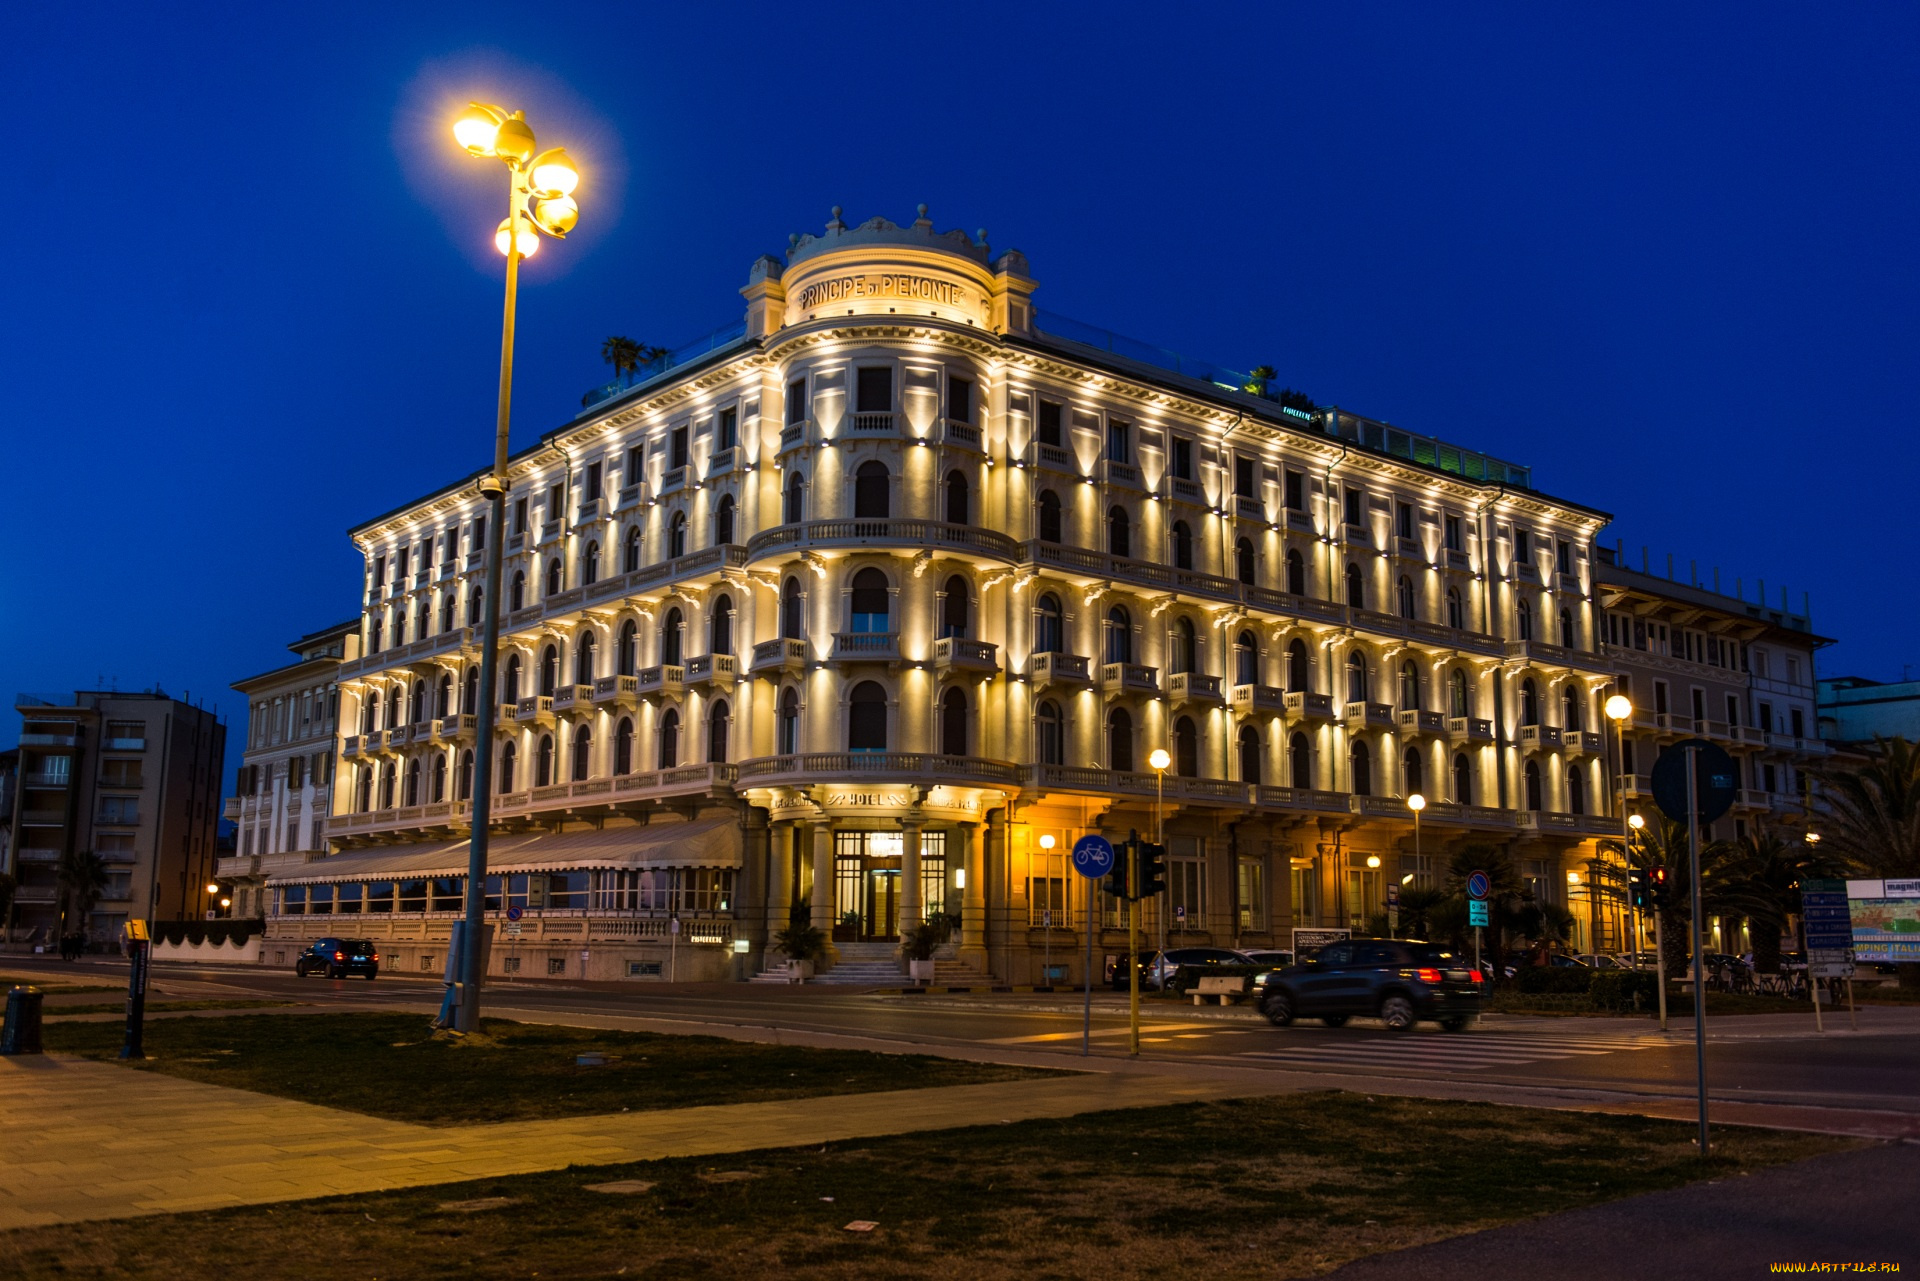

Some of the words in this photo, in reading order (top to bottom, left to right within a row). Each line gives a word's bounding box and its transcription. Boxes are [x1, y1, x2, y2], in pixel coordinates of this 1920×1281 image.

[802, 275, 866, 309] PRINCIPE
[881, 274, 961, 305] PIEMONTE
[850, 793, 885, 805] HOTEL
